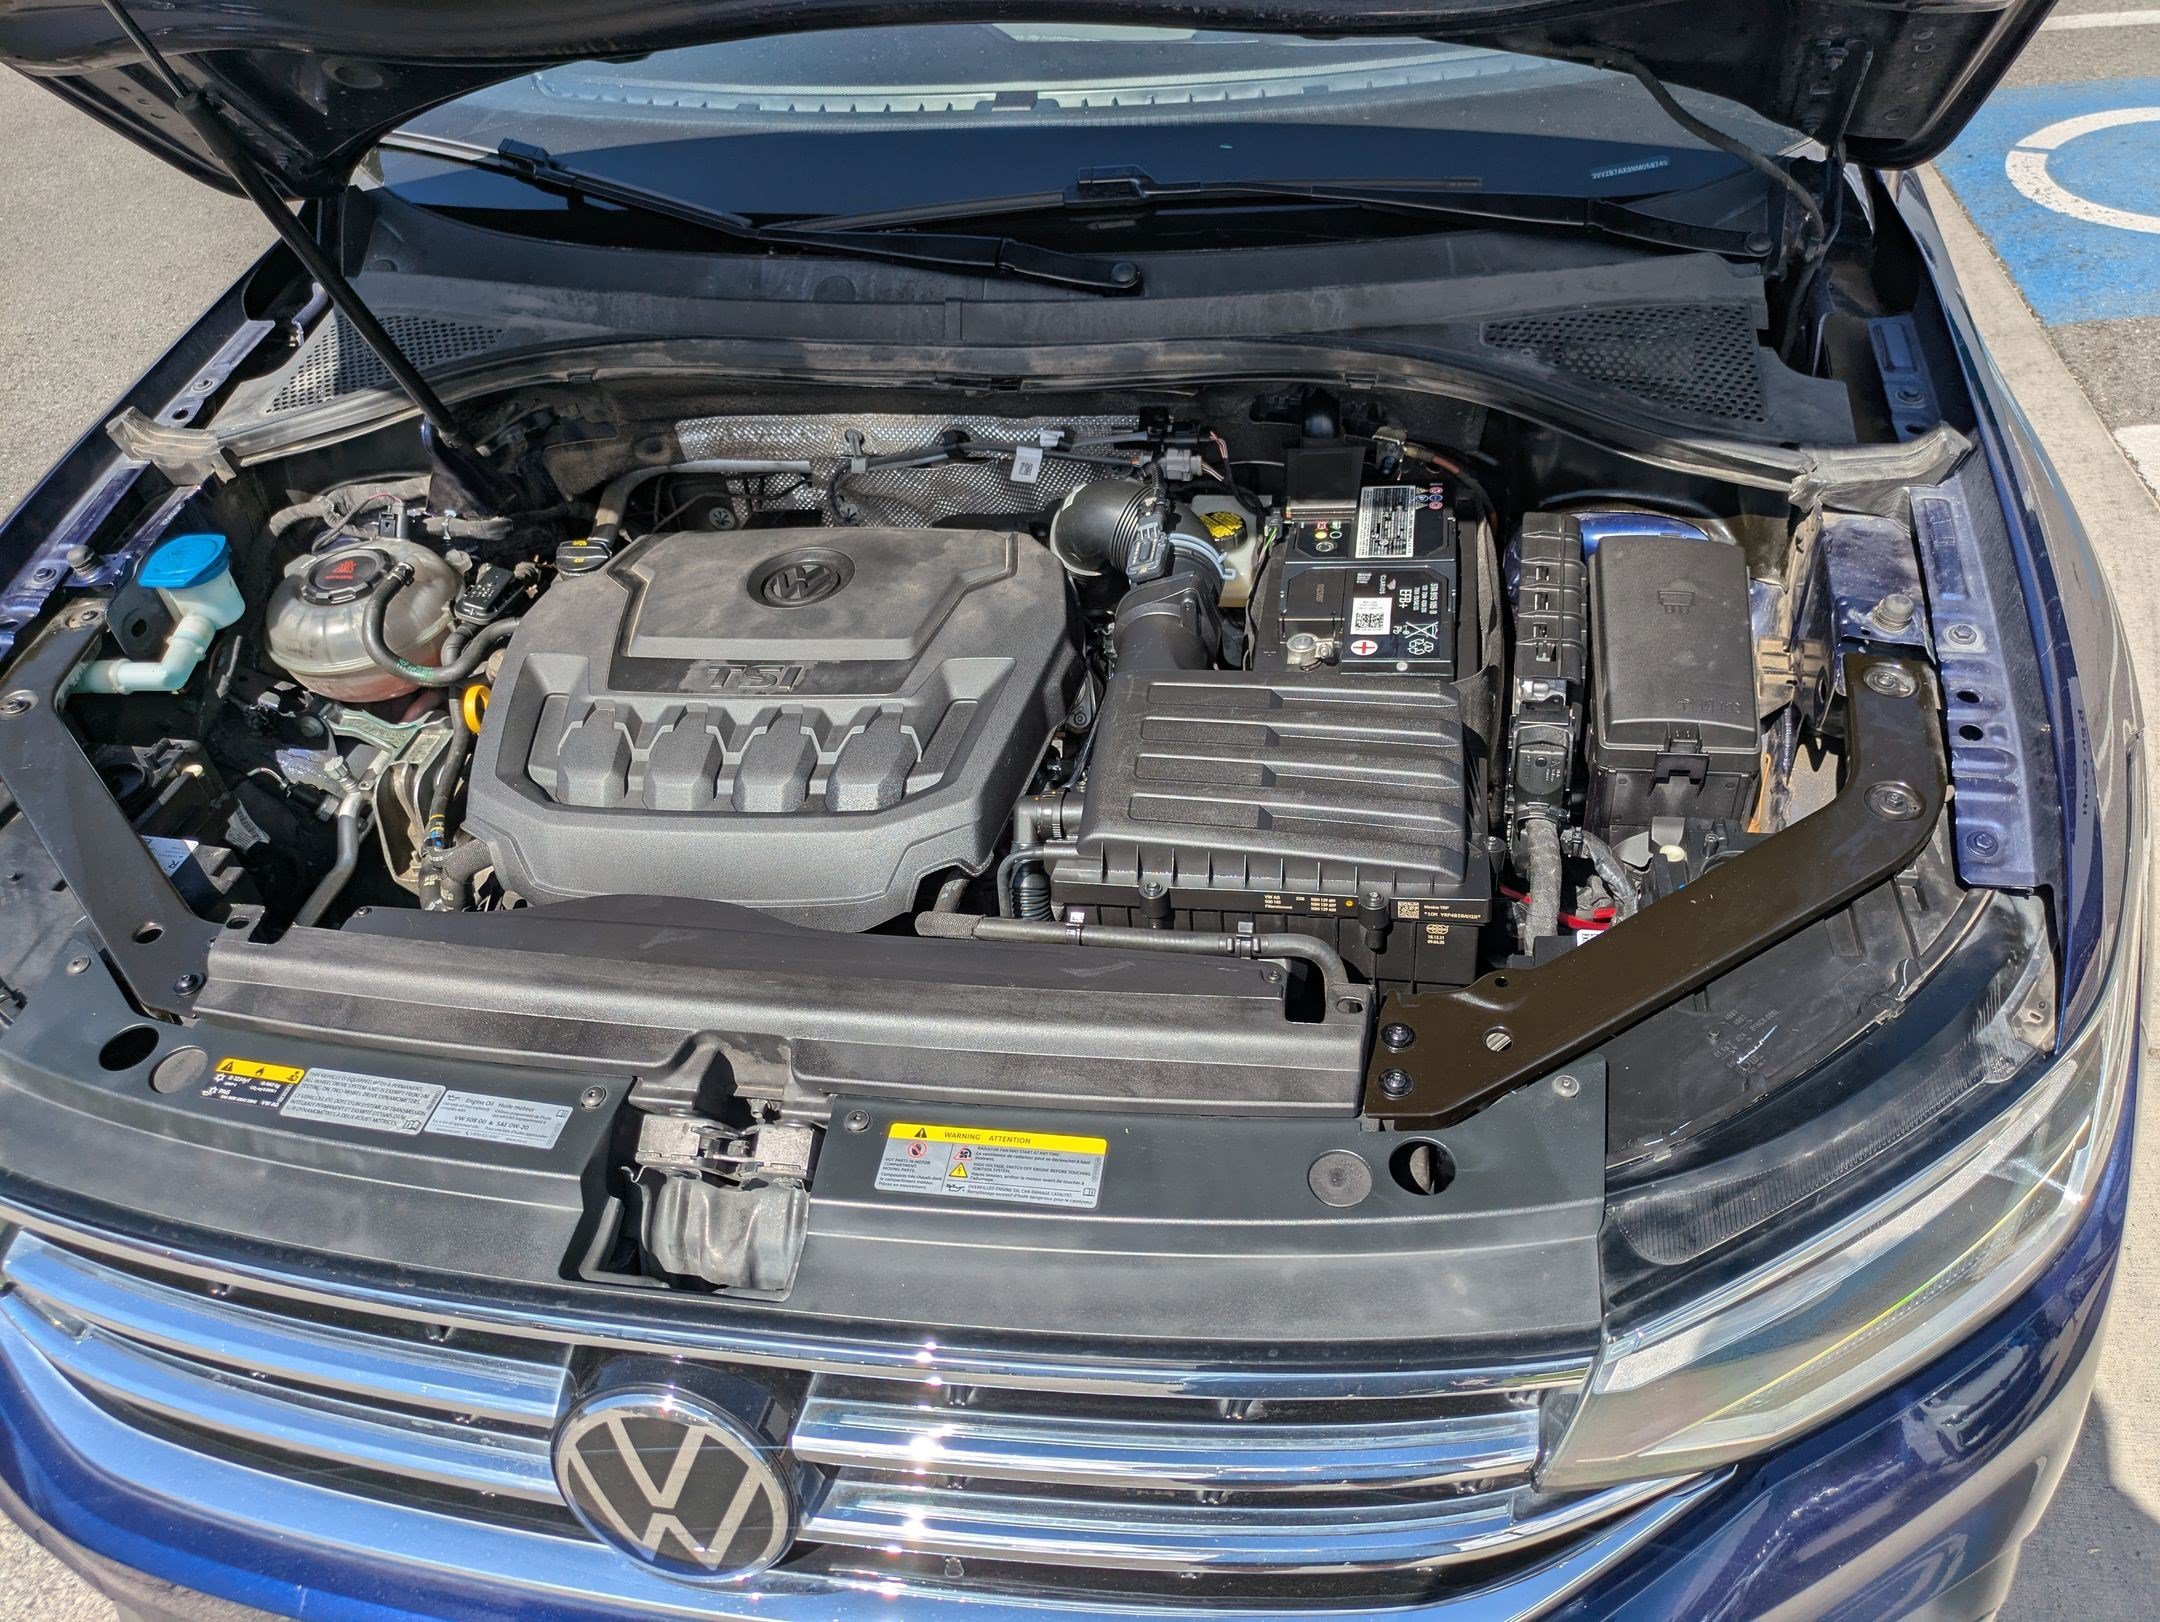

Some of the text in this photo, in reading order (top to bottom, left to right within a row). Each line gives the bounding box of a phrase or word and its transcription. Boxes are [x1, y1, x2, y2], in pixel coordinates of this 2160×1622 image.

[1399, 589, 1412, 608] EFB+
[708, 664, 804, 688] TSI
[464, 1097, 485, 1106] Engine
[944, 1132, 1031, 1144] WARNING ATTENTION
[557, 1409, 788, 1574] VW
